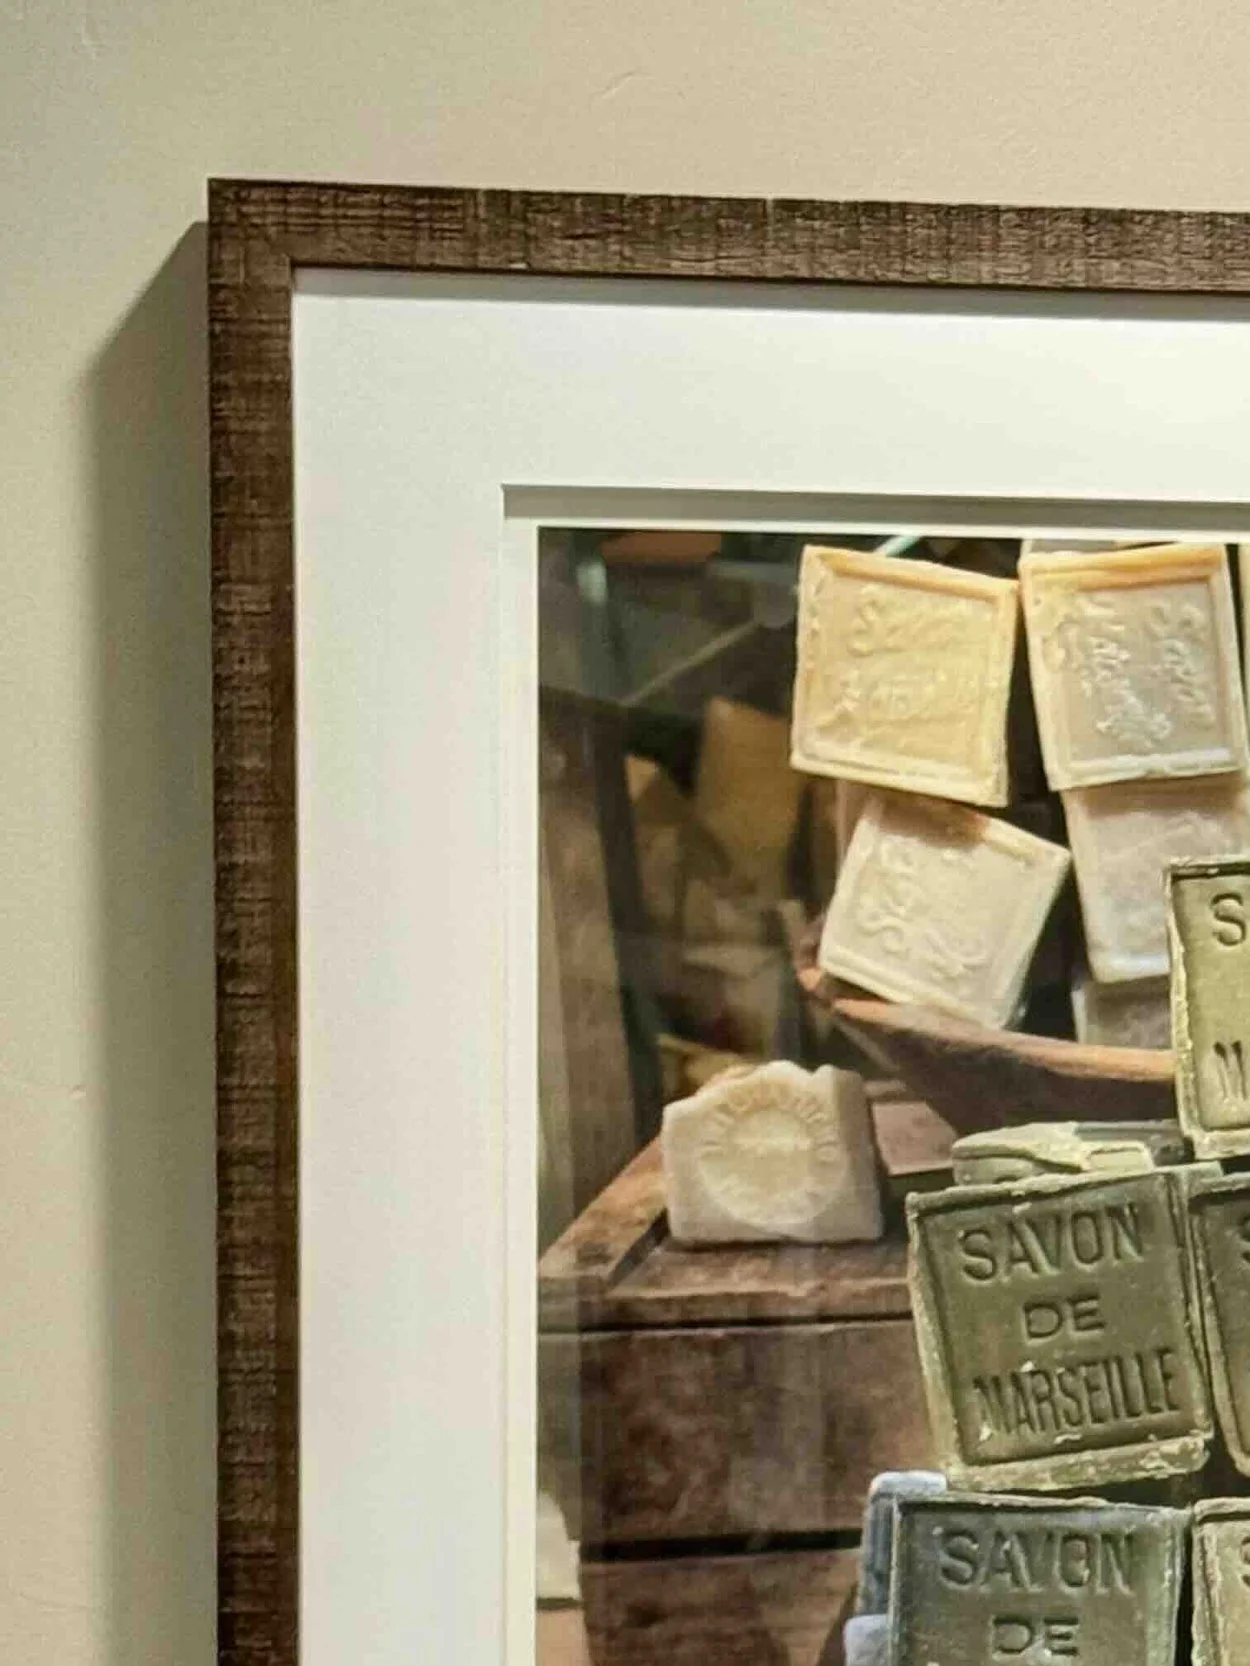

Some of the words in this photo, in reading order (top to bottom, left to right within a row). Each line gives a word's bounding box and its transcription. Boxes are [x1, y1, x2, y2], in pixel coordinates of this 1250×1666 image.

[960, 1202, 1144, 1281] SAVON
[1022, 1294, 1107, 1340] DE
[972, 1347, 1181, 1436] MARSEILLE
[938, 1528, 1134, 1588] SAVON
[991, 1614, 1081, 1657] DE
